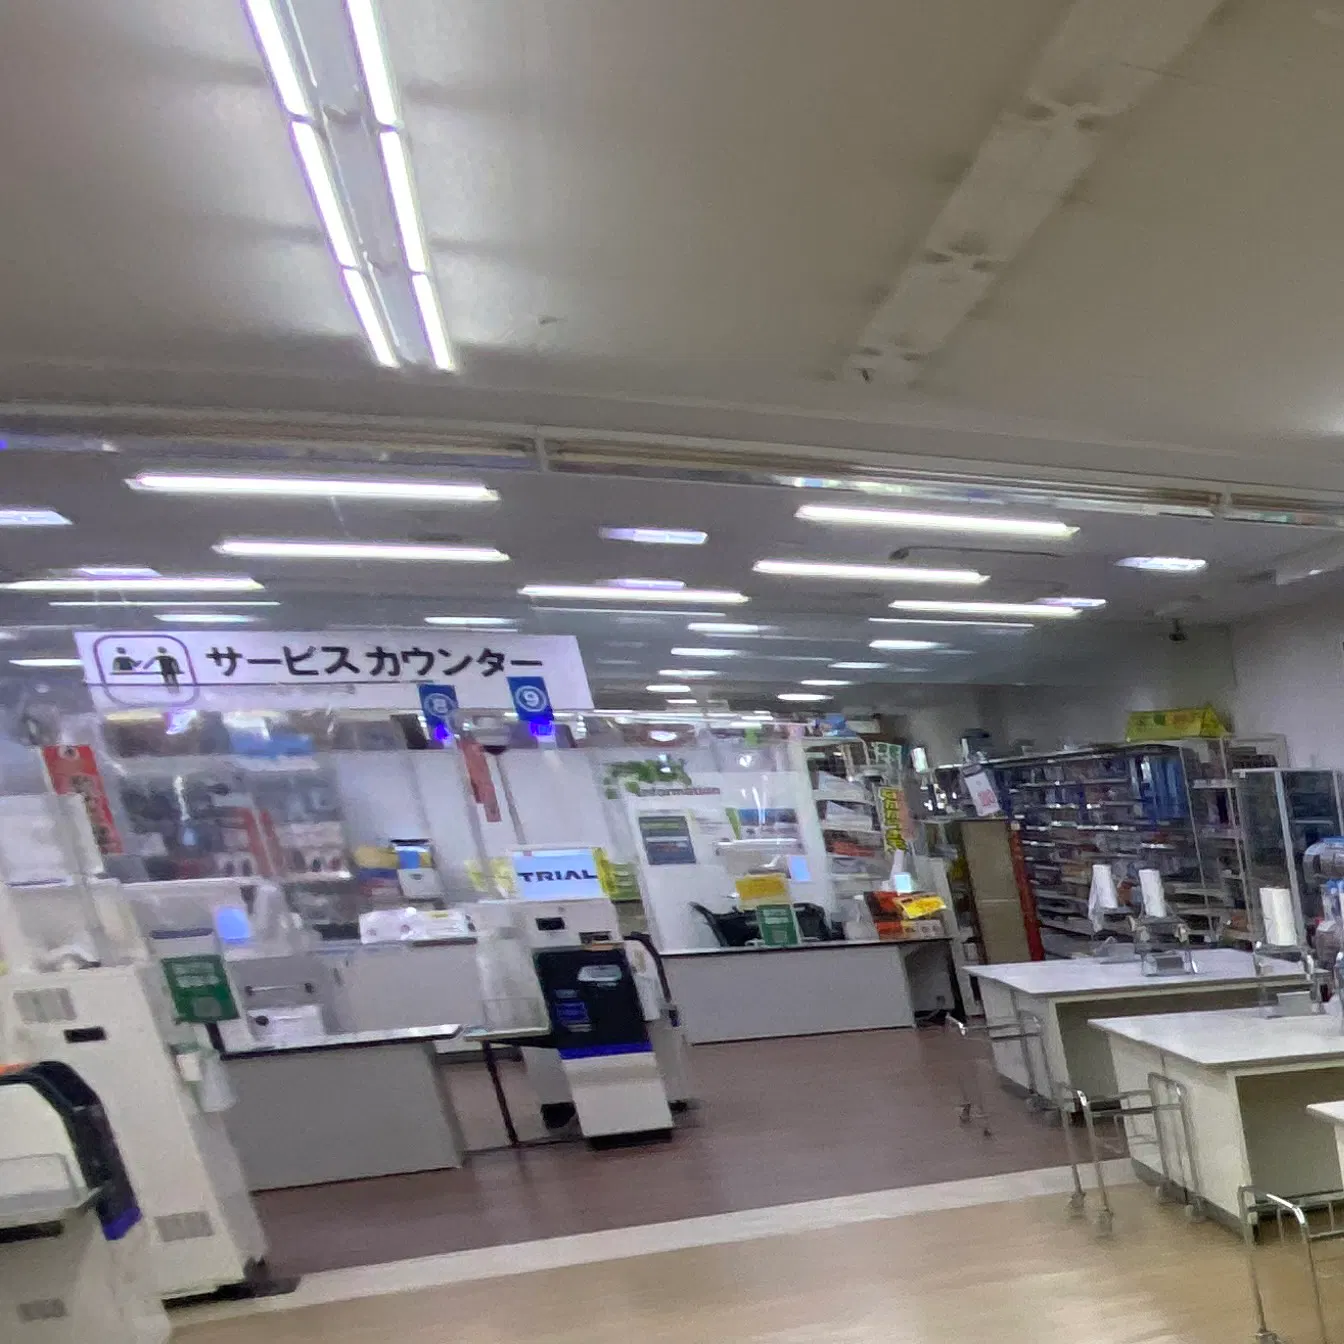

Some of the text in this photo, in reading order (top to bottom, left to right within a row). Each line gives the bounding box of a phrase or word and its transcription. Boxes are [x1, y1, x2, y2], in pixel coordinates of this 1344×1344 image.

[205, 644, 545, 680] サービスカウンター
[518, 869, 599, 886] TRIAL
